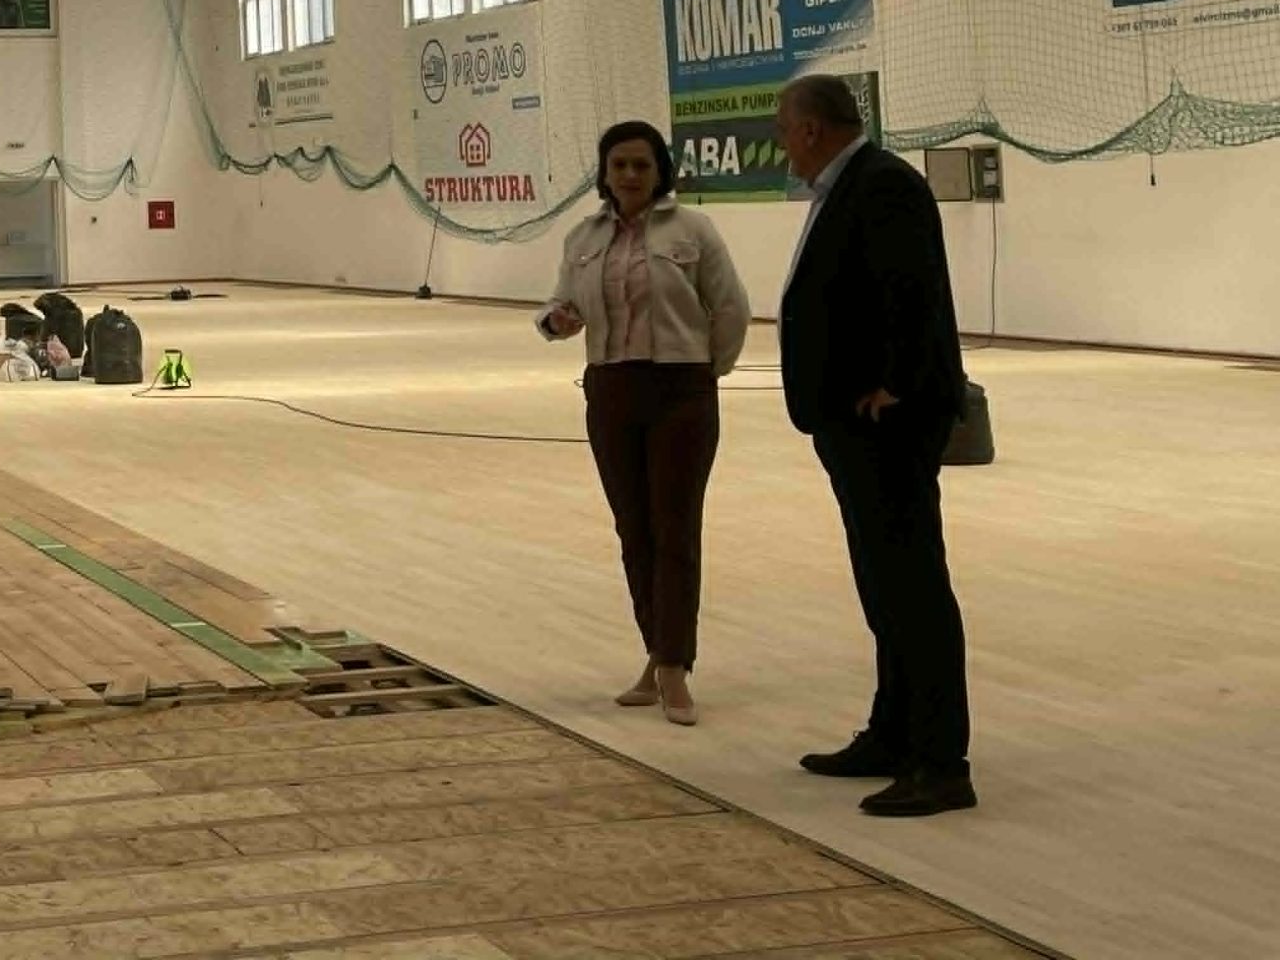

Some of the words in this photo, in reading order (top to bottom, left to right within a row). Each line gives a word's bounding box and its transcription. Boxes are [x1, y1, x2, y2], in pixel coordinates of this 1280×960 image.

[792, 23, 825, 38] DONJI
[451, 42, 526, 87] PROMO
[676, 96, 739, 116] BENZINSKA
[678, 136, 741, 178] ABA
[425, 174, 536, 202] STRUKTURA
